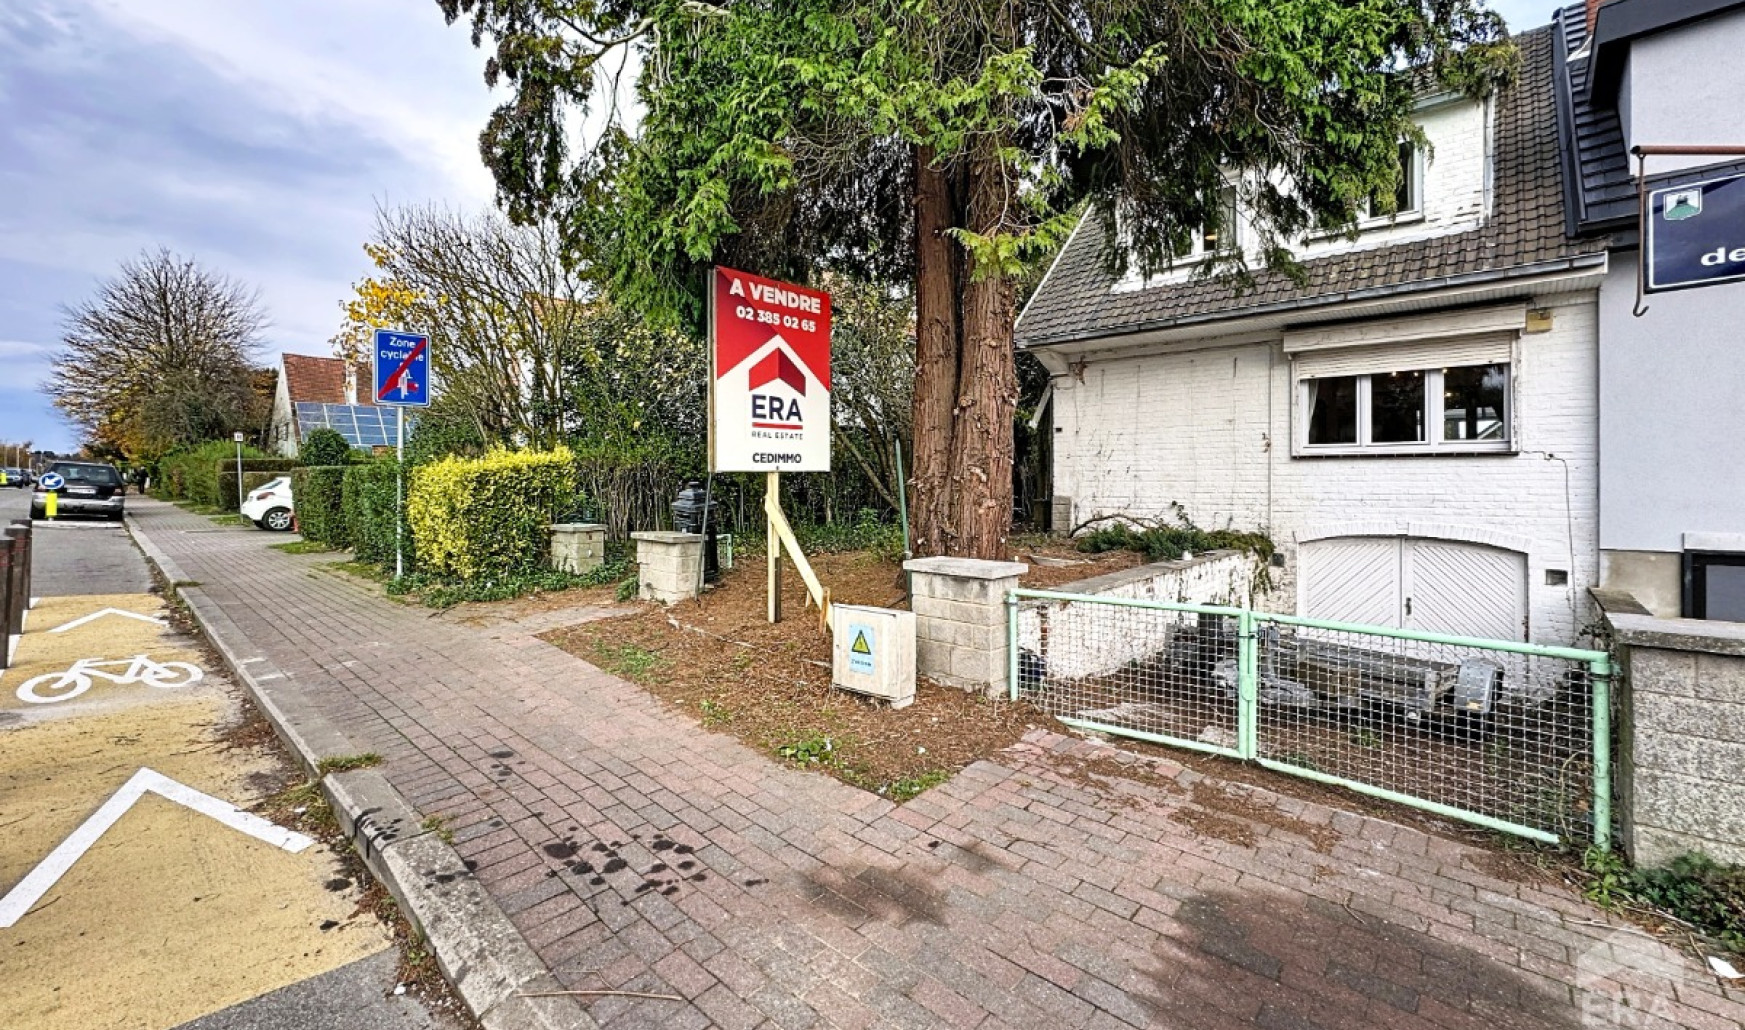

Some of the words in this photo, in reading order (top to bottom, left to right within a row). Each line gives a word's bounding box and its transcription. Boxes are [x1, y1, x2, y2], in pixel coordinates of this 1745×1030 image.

[729, 278, 745, 297] A
[748, 281, 821, 314] VENDRE
[736, 306, 754, 321] 02
[757, 309, 780, 326] 385
[783, 314, 799, 330] 02
[800, 318, 816, 333] 65
[389, 336, 416, 348] Zone
[751, 394, 803, 422] ERA
[751, 430, 772, 439] REAL
[774, 431, 803, 440] ESTATE
[752, 452, 802, 464] CEDIMMO
